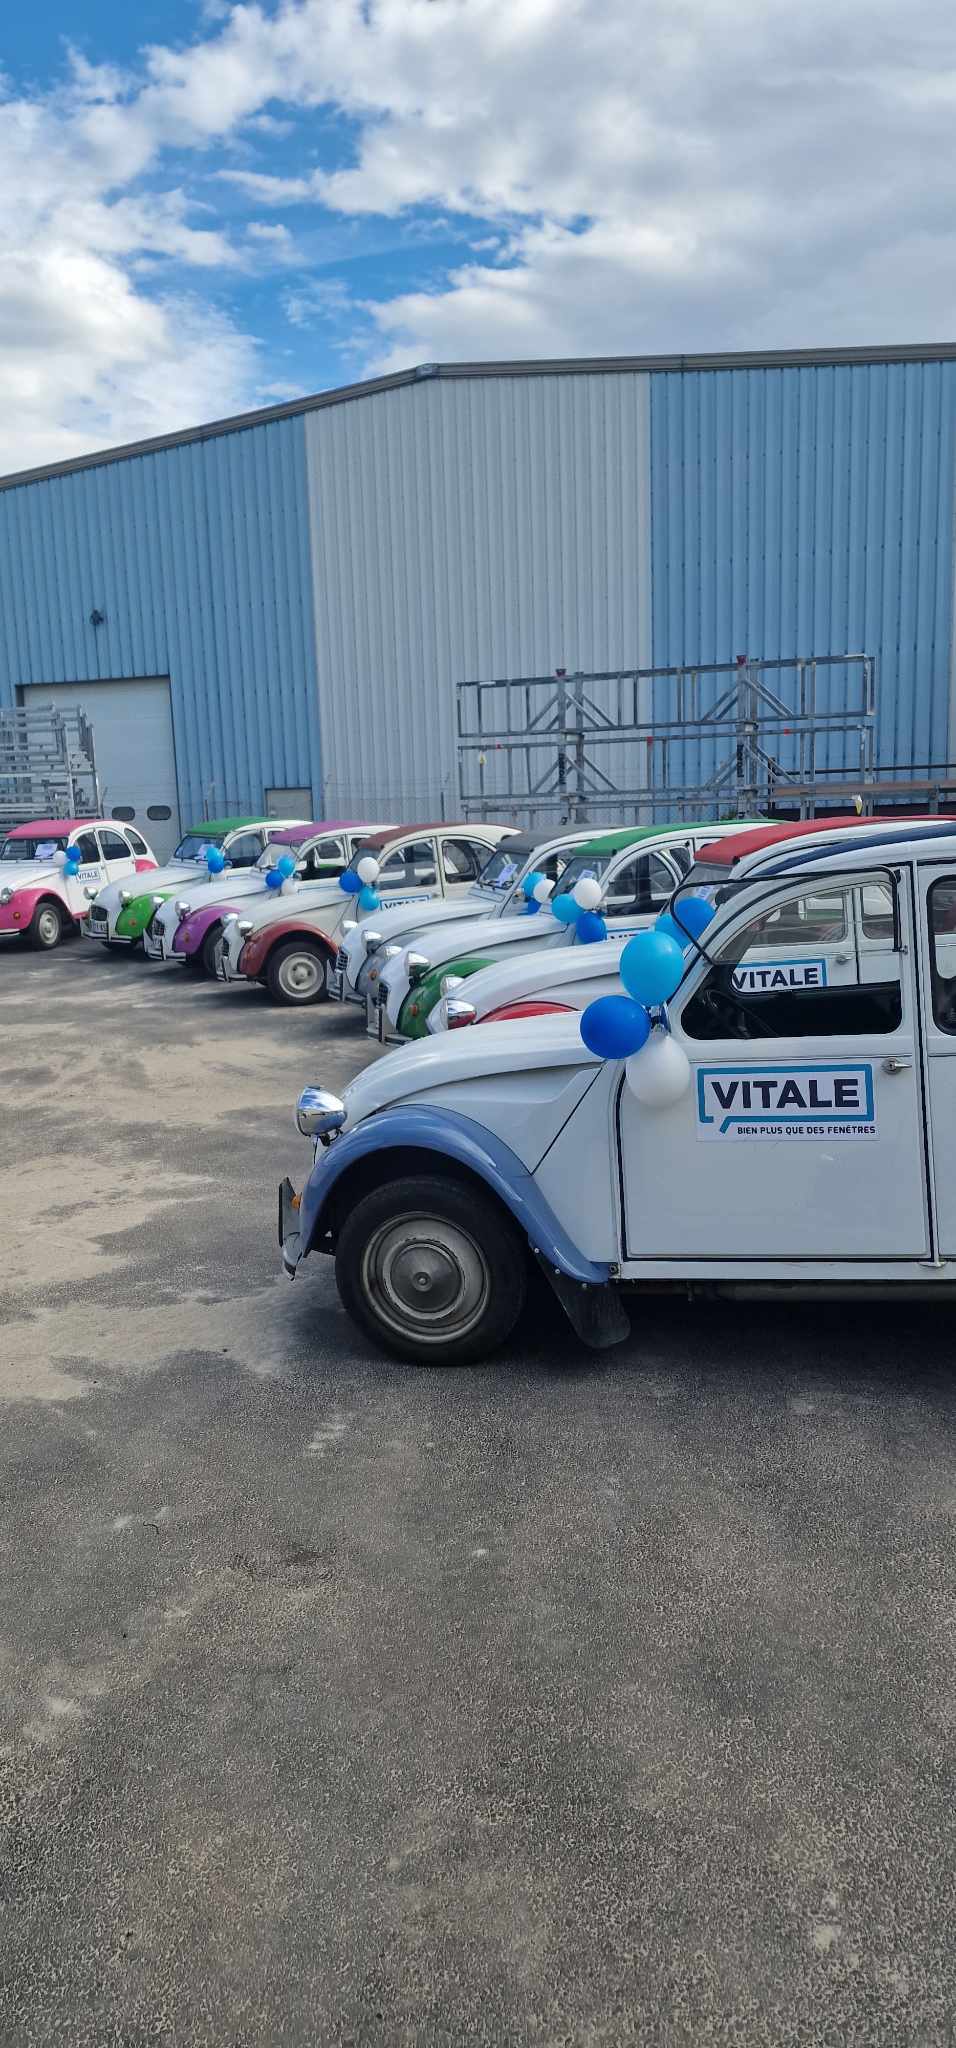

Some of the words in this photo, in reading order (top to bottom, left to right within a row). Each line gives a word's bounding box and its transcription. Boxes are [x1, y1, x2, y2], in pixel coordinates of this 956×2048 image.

[732, 967, 819, 989] VITALE
[711, 1078, 860, 1109] VITALE
[737, 1126, 758, 1135] BIEN
[760, 1126, 783, 1135] PLUS
[785, 1126, 805, 1135] QUE
[807, 1125, 825, 1134] DES
[827, 1125, 876, 1134] FENÊTRES
